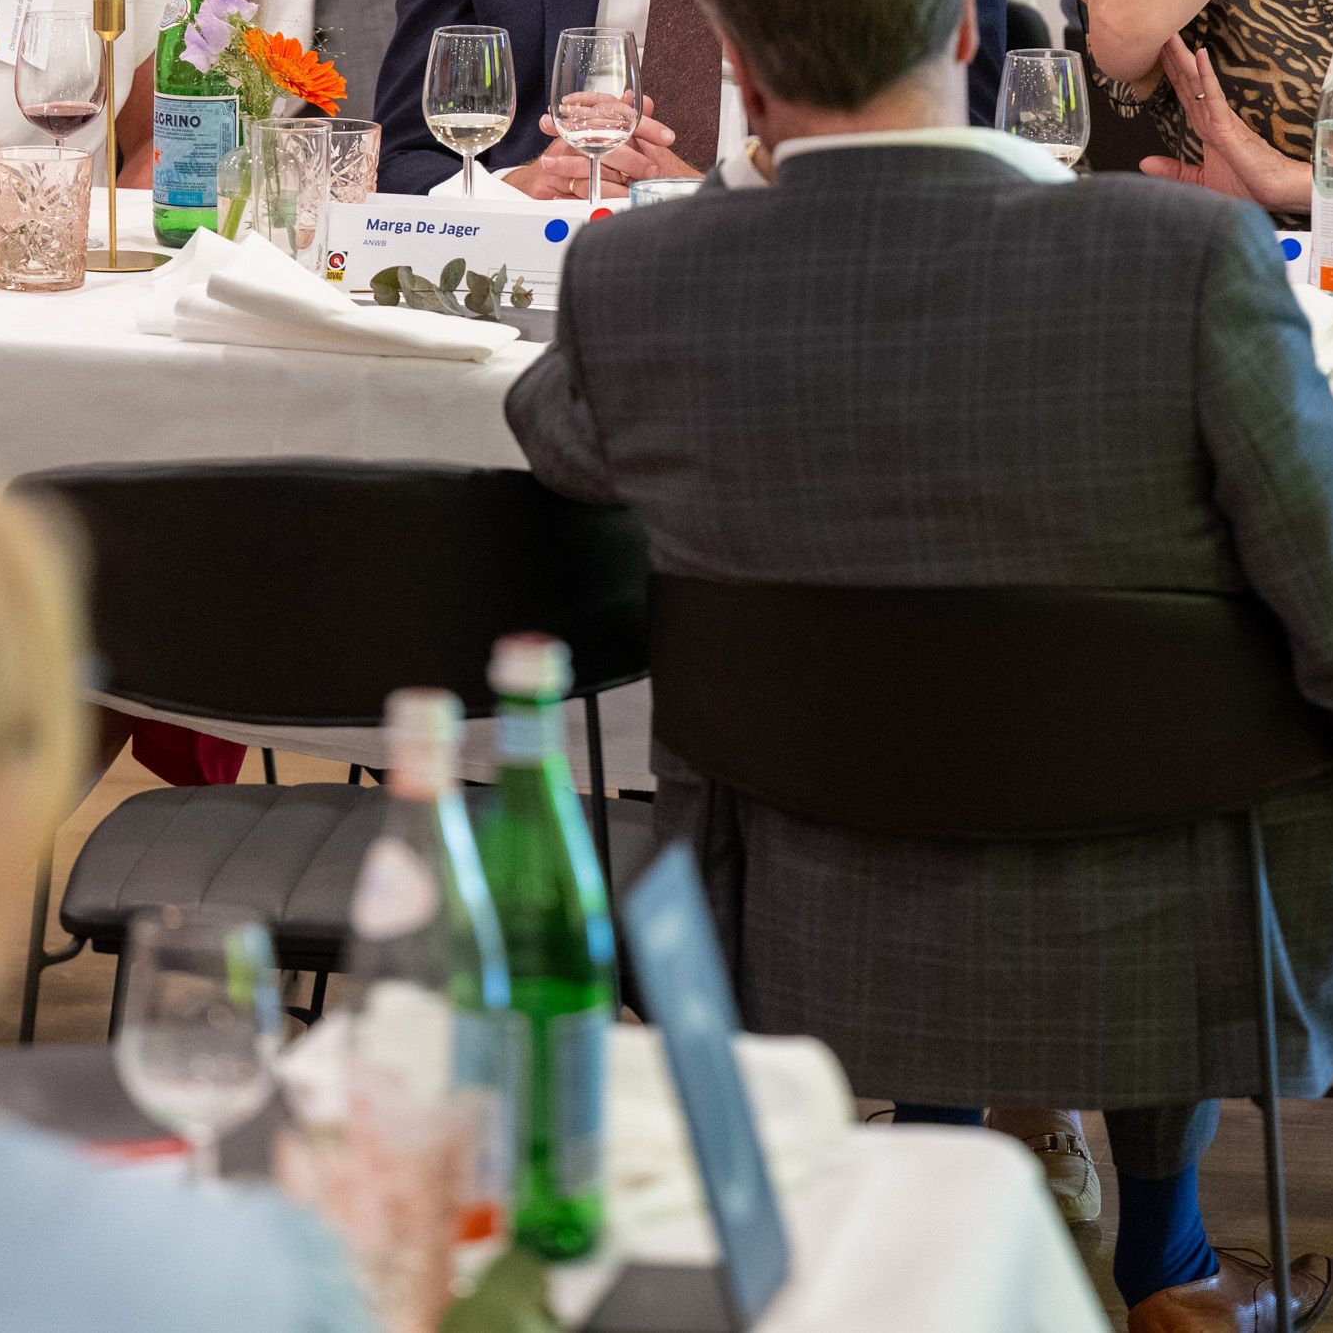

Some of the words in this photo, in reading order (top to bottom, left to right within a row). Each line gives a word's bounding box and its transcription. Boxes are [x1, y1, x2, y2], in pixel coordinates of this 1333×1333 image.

[366, 218, 411, 234] Marga
[416, 221, 435, 234] De
[439, 222, 480, 238] Jager
[363, 239, 386, 247] ANWB
